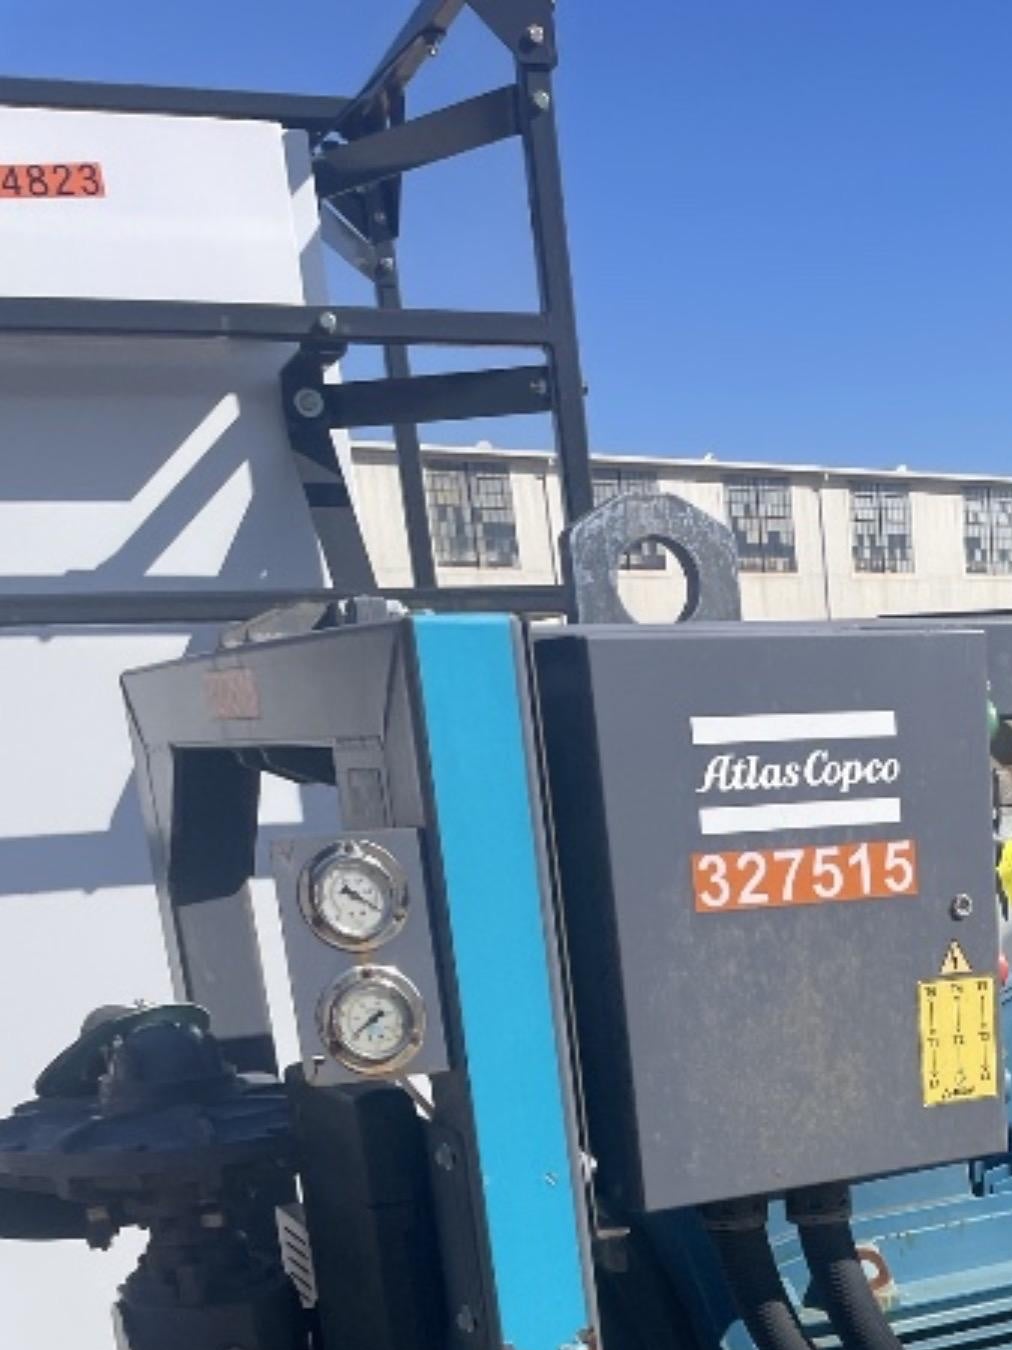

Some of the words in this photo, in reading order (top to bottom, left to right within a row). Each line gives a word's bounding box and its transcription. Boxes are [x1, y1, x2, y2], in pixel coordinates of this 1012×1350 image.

[1, 164, 101, 197] 4823
[696, 753, 799, 794] Atlas
[804, 749, 899, 793] Copco
[698, 840, 914, 907] 327515
